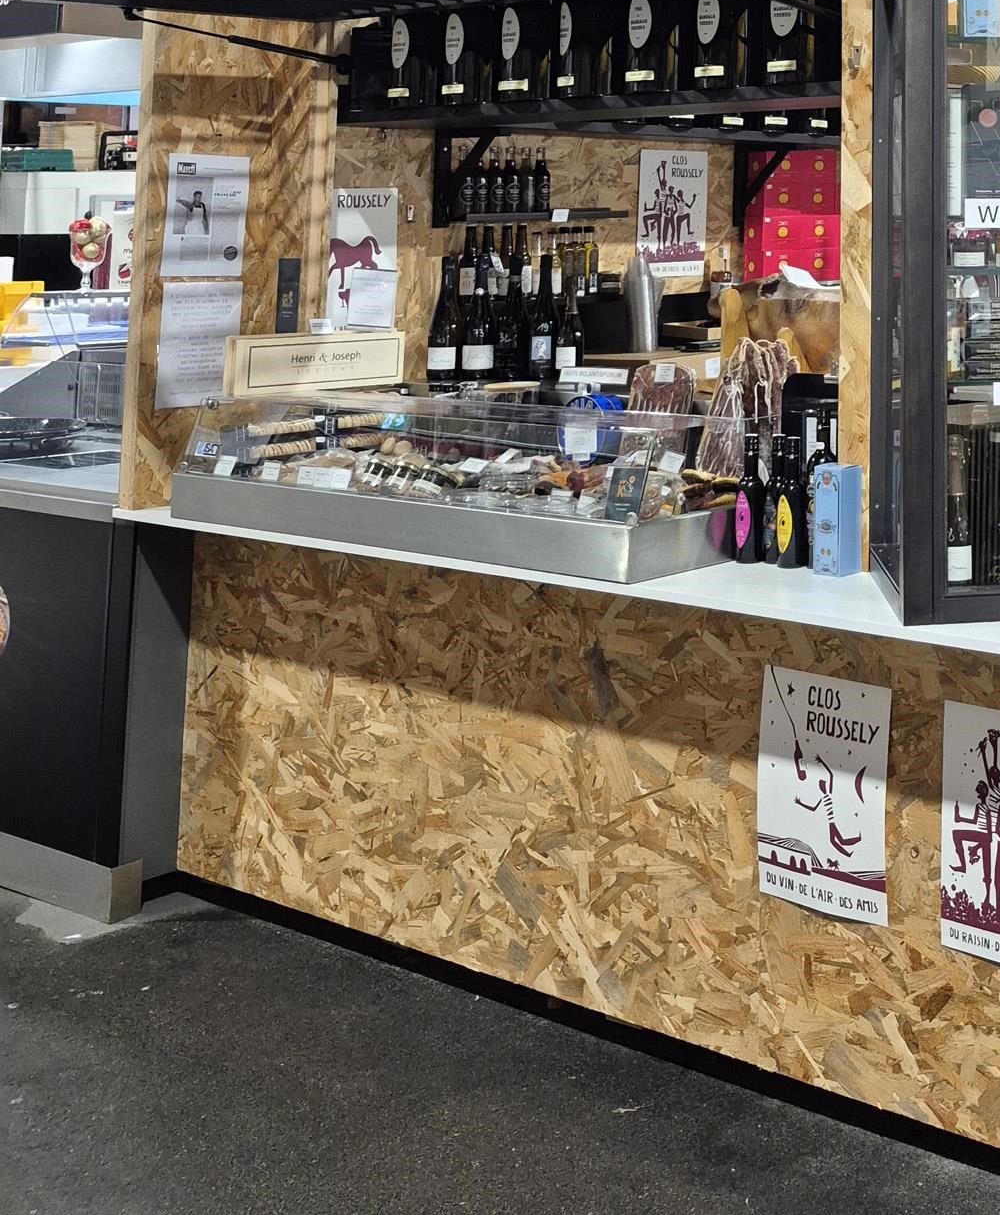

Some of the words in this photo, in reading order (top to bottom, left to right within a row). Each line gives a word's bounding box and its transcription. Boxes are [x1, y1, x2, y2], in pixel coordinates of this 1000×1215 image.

[671, 155, 688, 165] CLOS
[671, 166, 704, 178] ROUSSELY
[337, 194, 391, 209] ROUSSELY
[291, 352, 315, 363] Henri
[331, 350, 361, 362] Joseph
[807, 685, 841, 711] CLOS
[806, 711, 880, 745] ROUSSELY
[766, 871, 777, 886] DU
[779, 875, 794, 891] VIN
[799, 881, 808, 896] DE
[811, 885, 833, 903] L'AIR
[839, 892, 854, 910] DES
[856, 897, 879, 914] AMIS
[949, 927, 960, 941] DU
[961, 930, 991, 950] RAISIN
